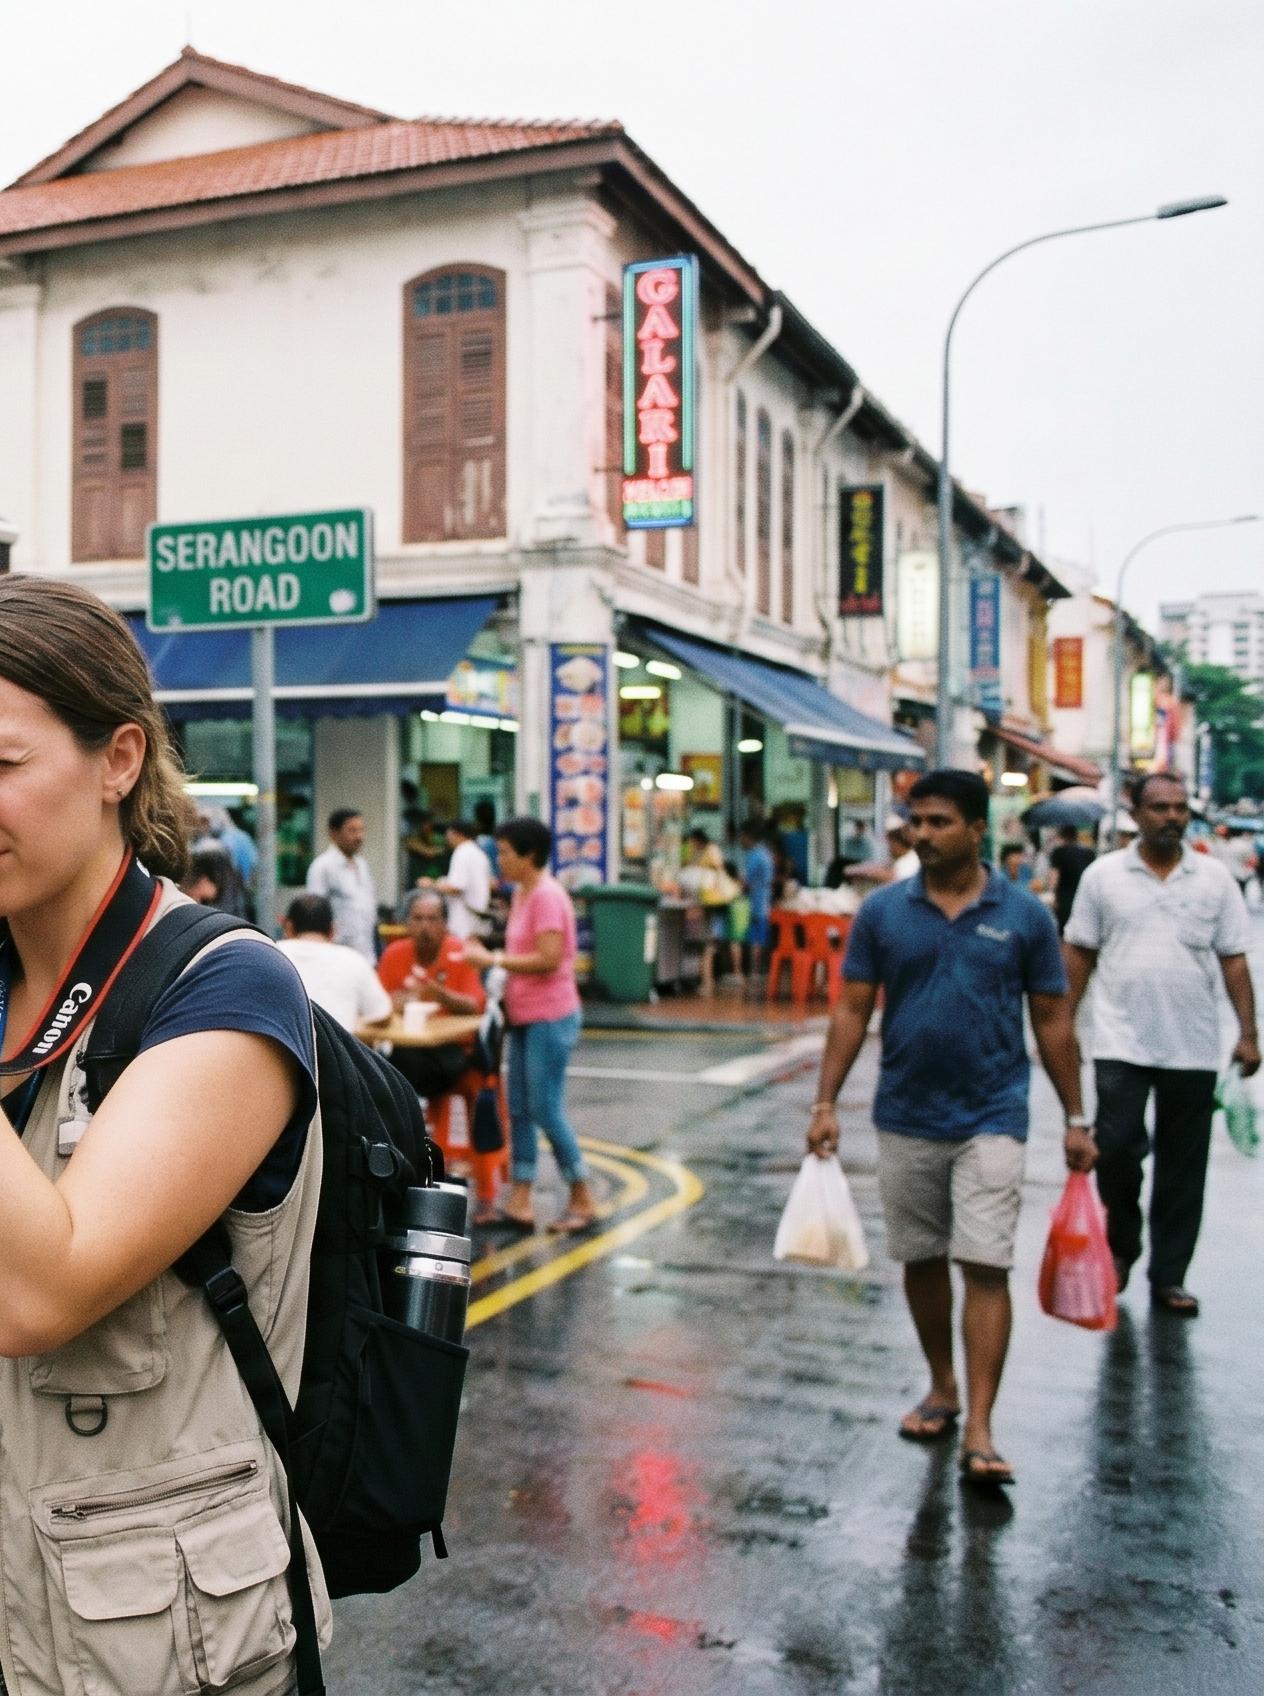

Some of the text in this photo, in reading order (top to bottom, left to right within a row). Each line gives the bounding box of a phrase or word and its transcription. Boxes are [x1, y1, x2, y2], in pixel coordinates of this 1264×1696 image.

[636, 268, 679, 478] GALARI
[156, 521, 358, 573] SERANGOON
[210, 573, 300, 615] ROAD
[32, 982, 93, 1055] Canon
